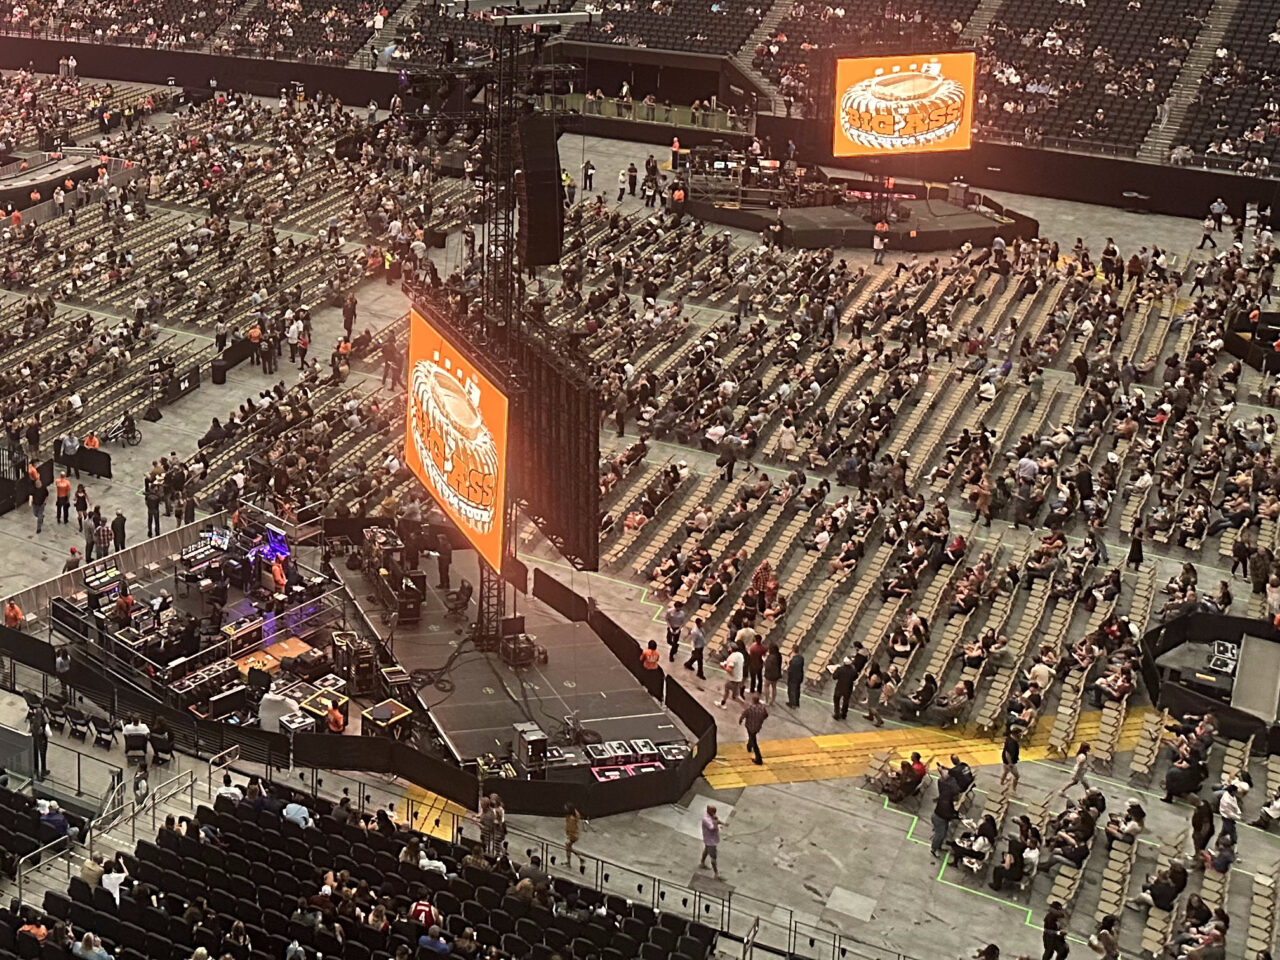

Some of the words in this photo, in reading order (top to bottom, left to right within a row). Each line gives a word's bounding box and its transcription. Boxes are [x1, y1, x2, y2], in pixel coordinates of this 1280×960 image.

[846, 107, 895, 136] BIG
[899, 102, 961, 136] ASS
[447, 453, 494, 507] ASS
[419, 911, 426, 924] 4
